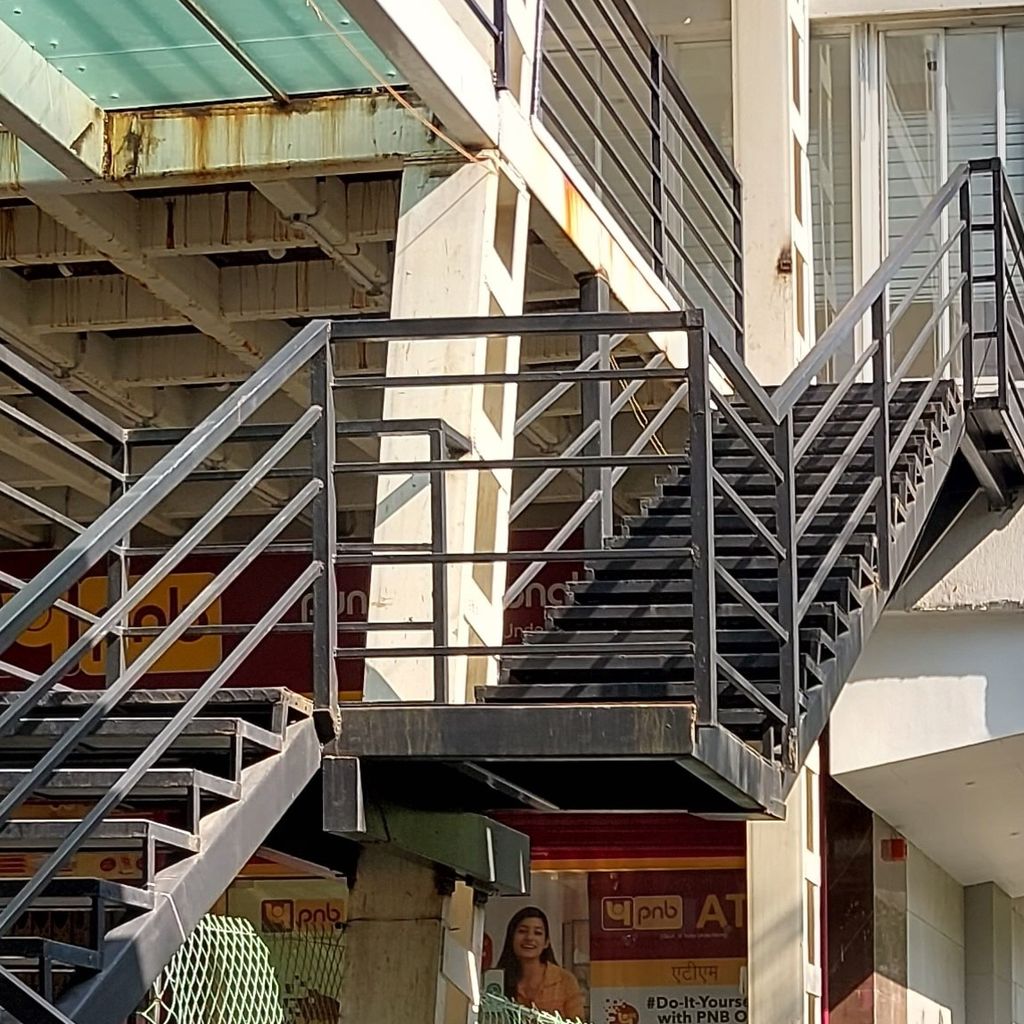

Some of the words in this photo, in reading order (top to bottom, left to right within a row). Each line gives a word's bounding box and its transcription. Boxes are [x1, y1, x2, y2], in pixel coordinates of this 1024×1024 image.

[299, 902, 341, 927] pnb
[638, 900, 678, 925] pnb
[657, 1010, 692, 1024] with
[697, 1010, 730, 1023] PNB
